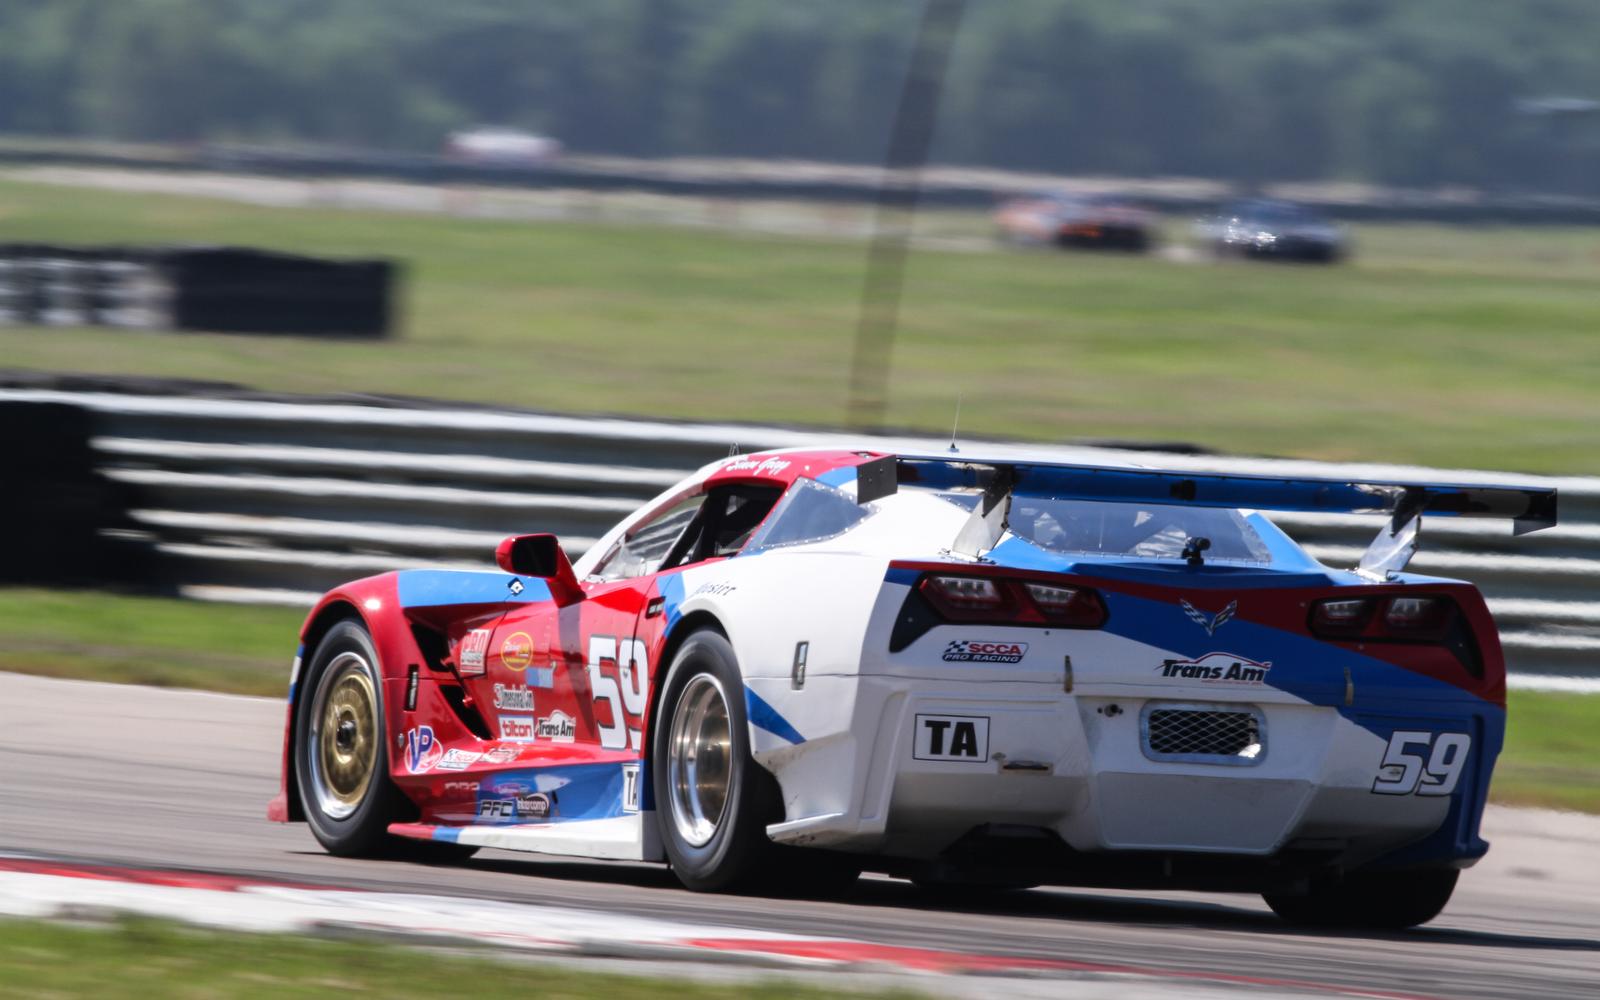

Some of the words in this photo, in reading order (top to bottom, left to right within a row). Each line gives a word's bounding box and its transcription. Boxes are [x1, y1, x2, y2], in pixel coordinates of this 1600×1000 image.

[944, 653, 970, 661] PRO
[968, 643, 1022, 655] SCCA
[1162, 659, 1222, 680] Trans
[1223, 662, 1265, 682] Am
[588, 635, 648, 752] 59
[537, 720, 559, 736] Trans
[560, 720, 574, 737] Am
[925, 720, 978, 757] TA
[409, 725, 434, 772] VP
[1371, 730, 1471, 797] 59
[480, 800, 513, 817] PFC
